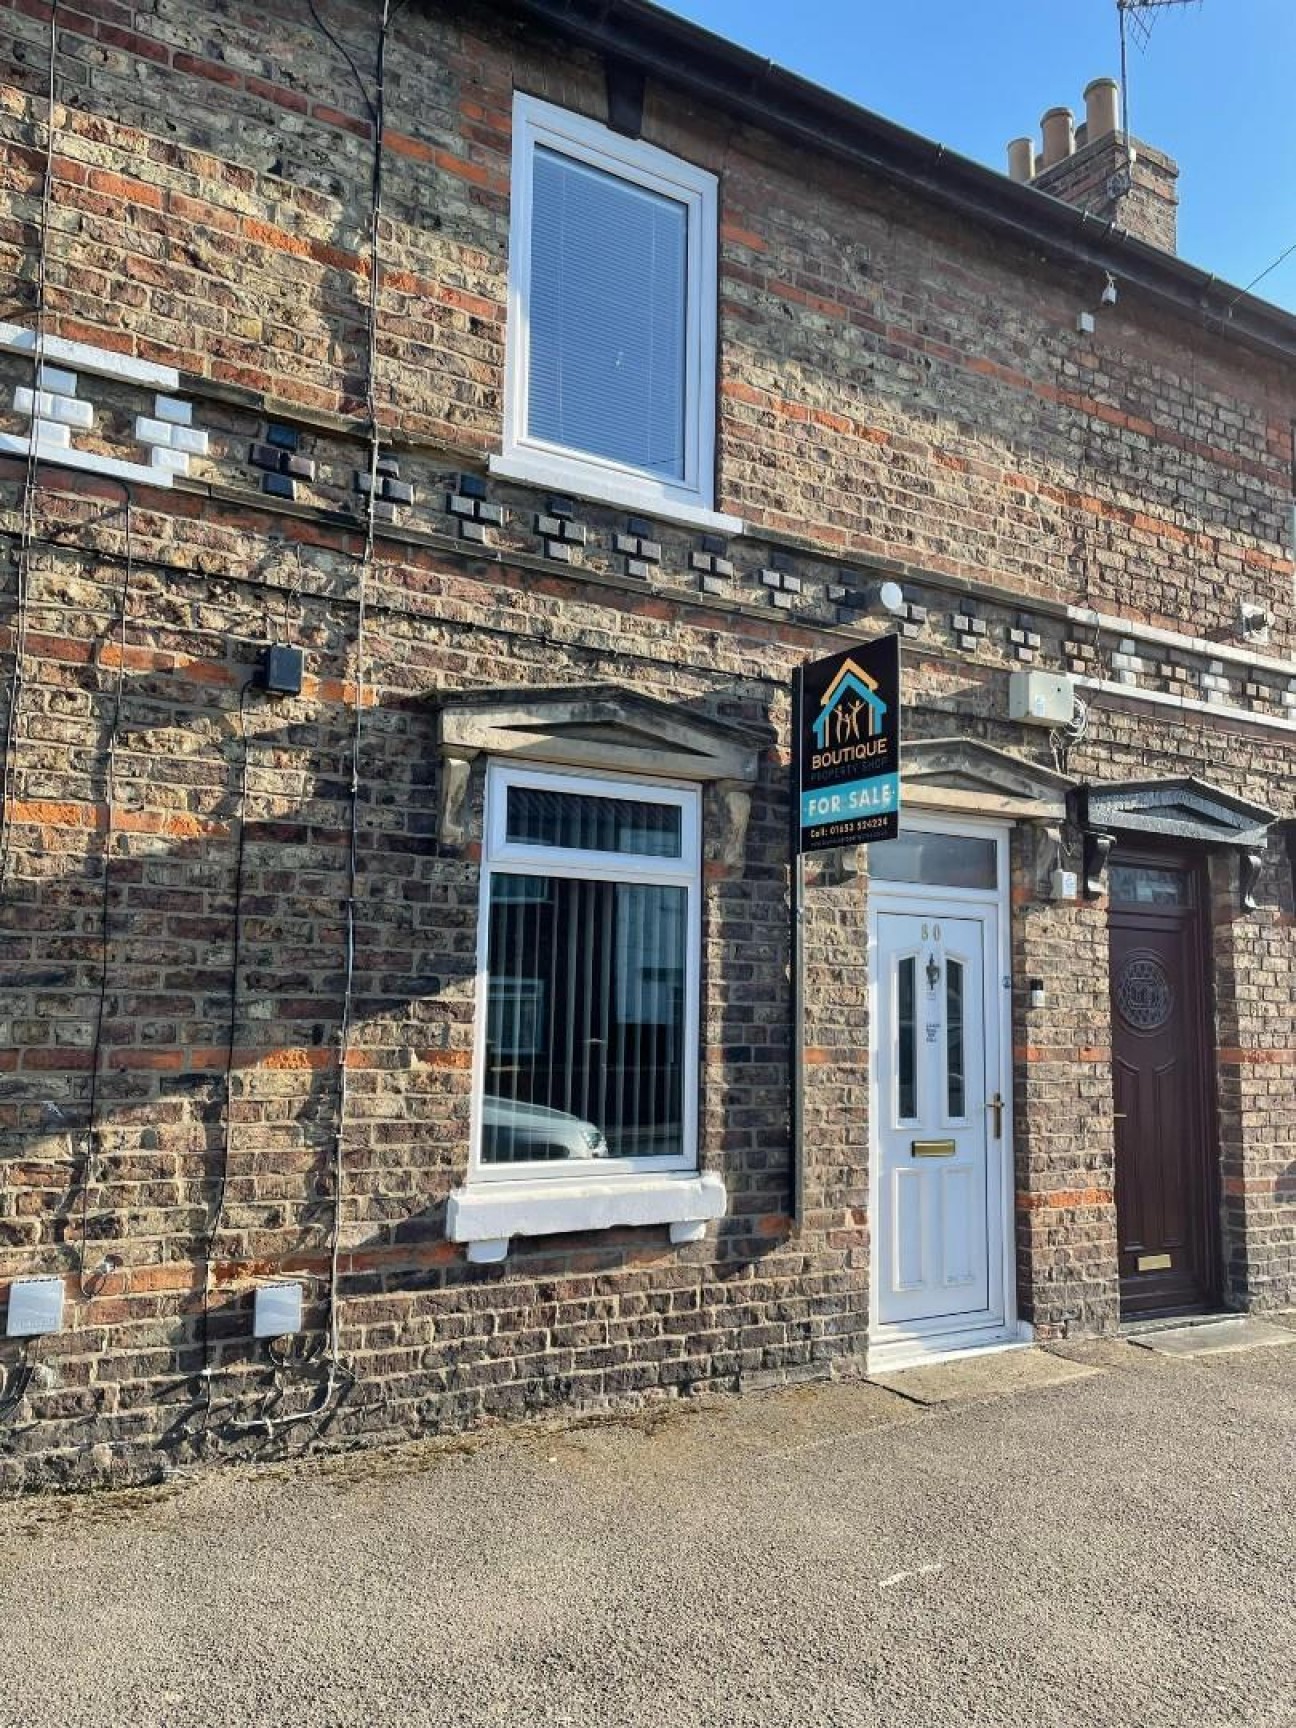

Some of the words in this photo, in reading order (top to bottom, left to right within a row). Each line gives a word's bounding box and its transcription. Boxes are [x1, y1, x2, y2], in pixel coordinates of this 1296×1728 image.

[812, 738, 888, 769] BOUTIQUE
[809, 794, 841, 817] FOR
[849, 784, 892, 809] SALE
[810, 826, 828, 838] Call:
[921, 923, 941, 941] 80
